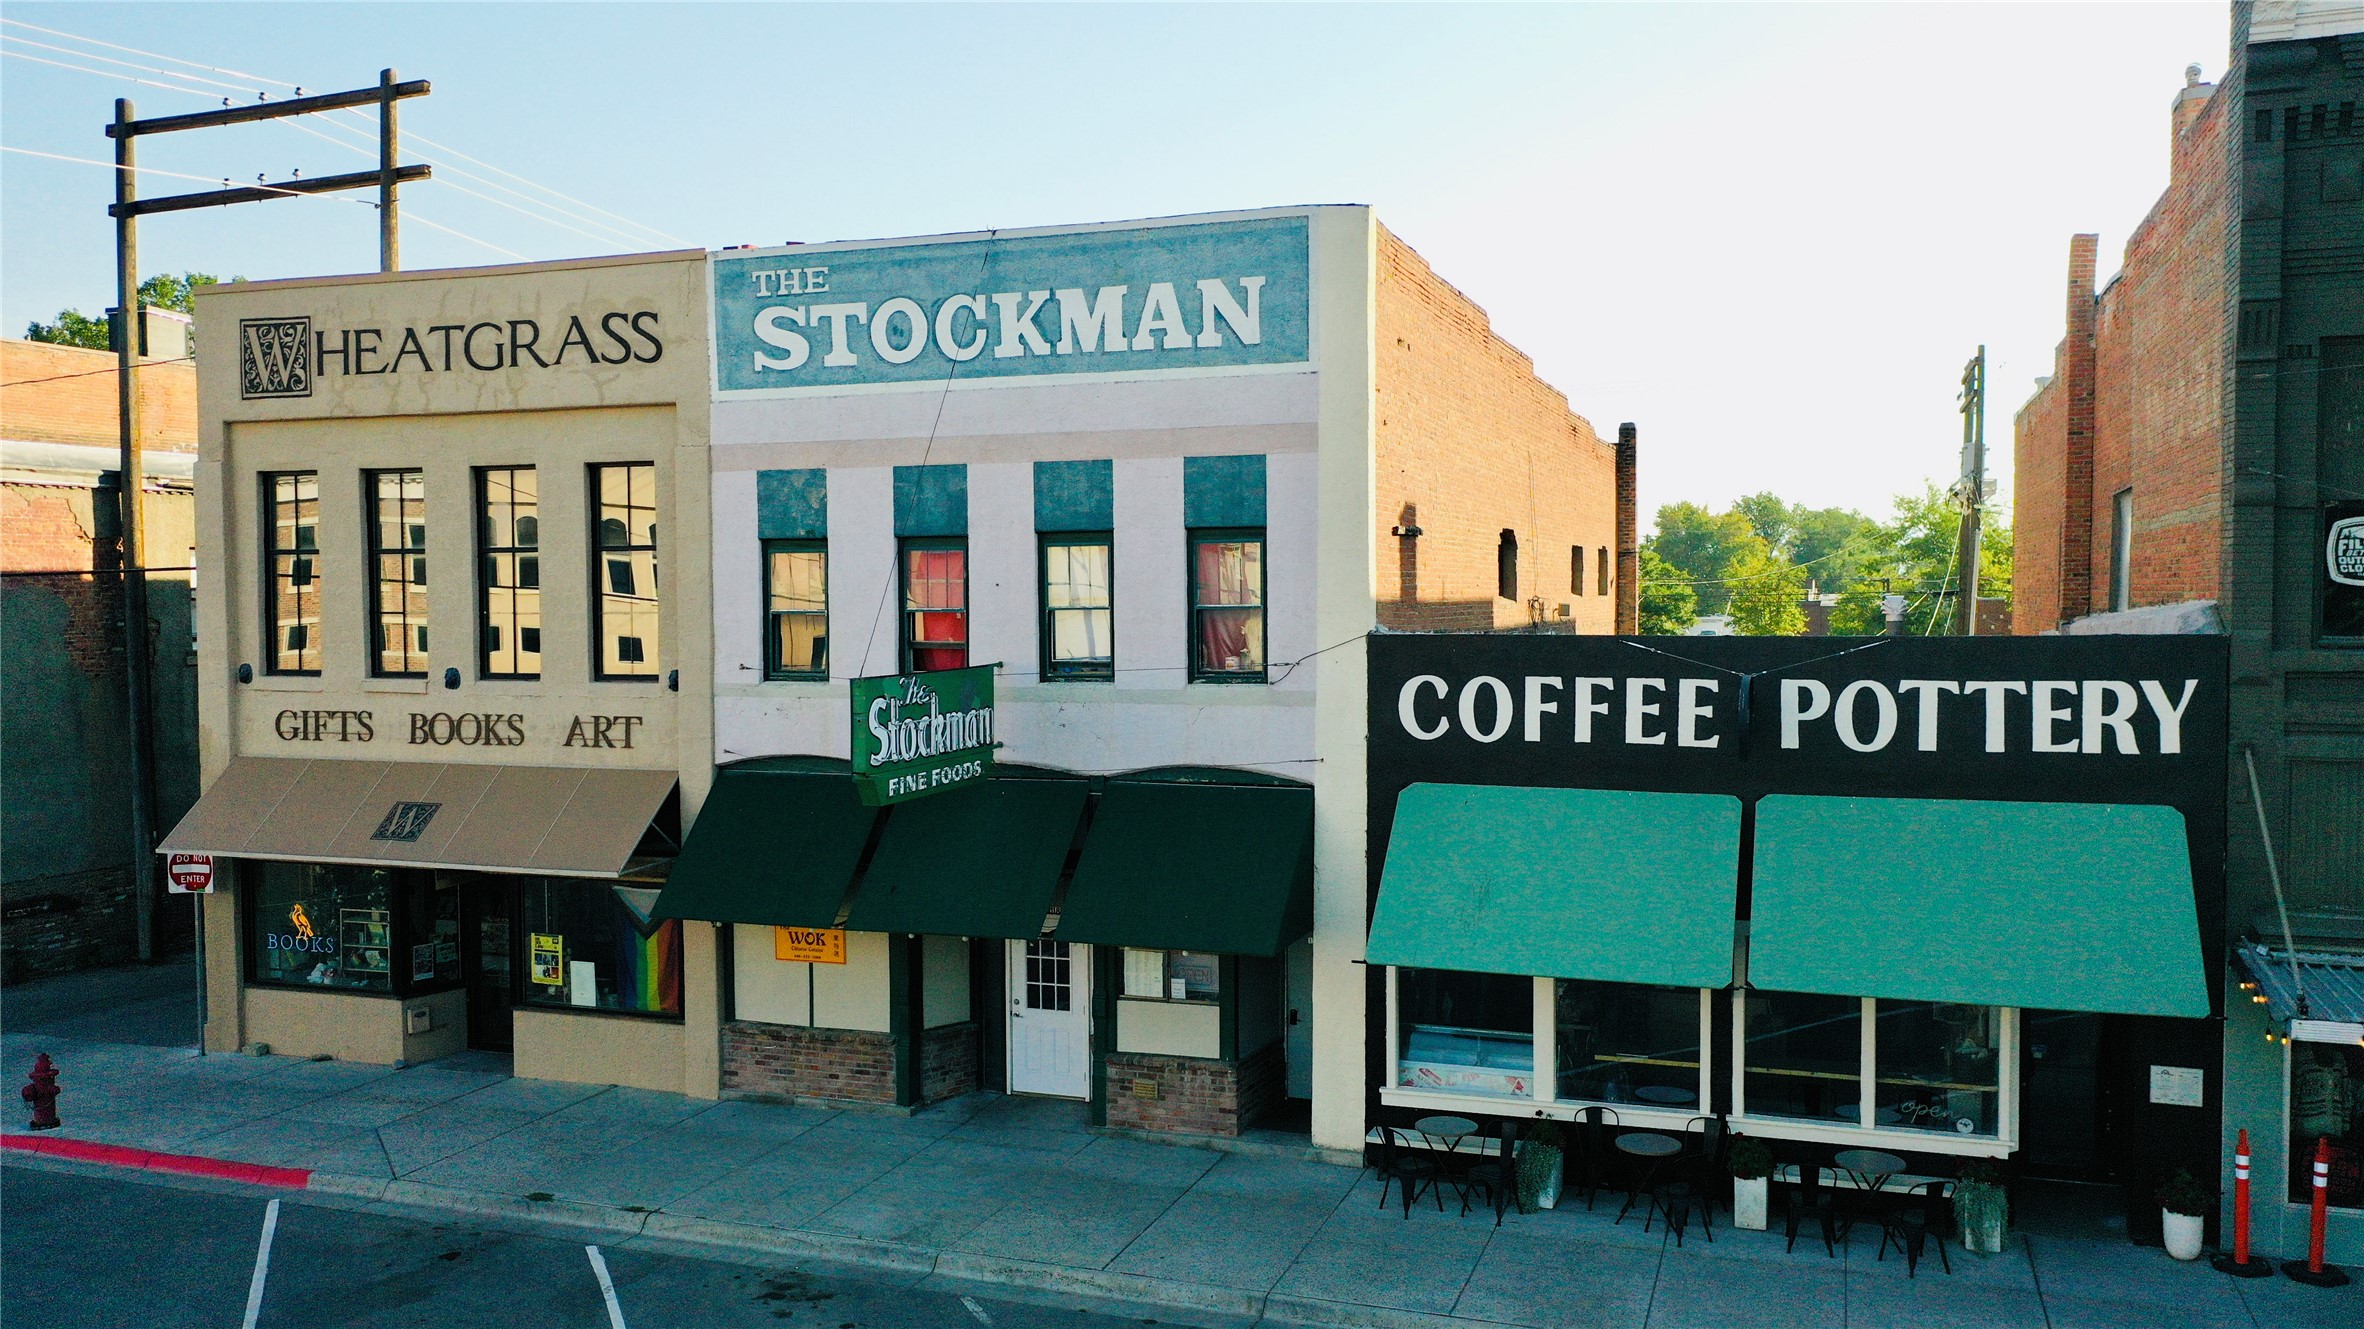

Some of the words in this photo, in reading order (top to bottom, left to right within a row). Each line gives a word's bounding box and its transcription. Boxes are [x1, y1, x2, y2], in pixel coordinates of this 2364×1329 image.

[751, 267, 829, 297] THE
[753, 276, 1266, 372] STOCKMAN
[241, 311, 664, 398] WHEATGRASS
[2338, 539, 2364, 557] FIL
[2339, 564, 2364, 573] CLO
[899, 676, 930, 705] The
[274, 709, 374, 743] GIFTS
[408, 712, 524, 746] BOOKS
[563, 714, 643, 749] ART
[869, 692, 994, 766] Stockman
[1398, 674, 1720, 750] COFFEE
[1780, 678, 2199, 756] POTTERY
[889, 772, 927, 797] FINE
[931, 760, 982, 787] FOODS
[176, 855, 189, 863] DO
[193, 854, 206, 863] NOT
[180, 874, 205, 883] ENTER
[267, 933, 335, 954] BOOKS
[788, 931, 826, 946] WOK
[1901, 1101, 1958, 1123] open
